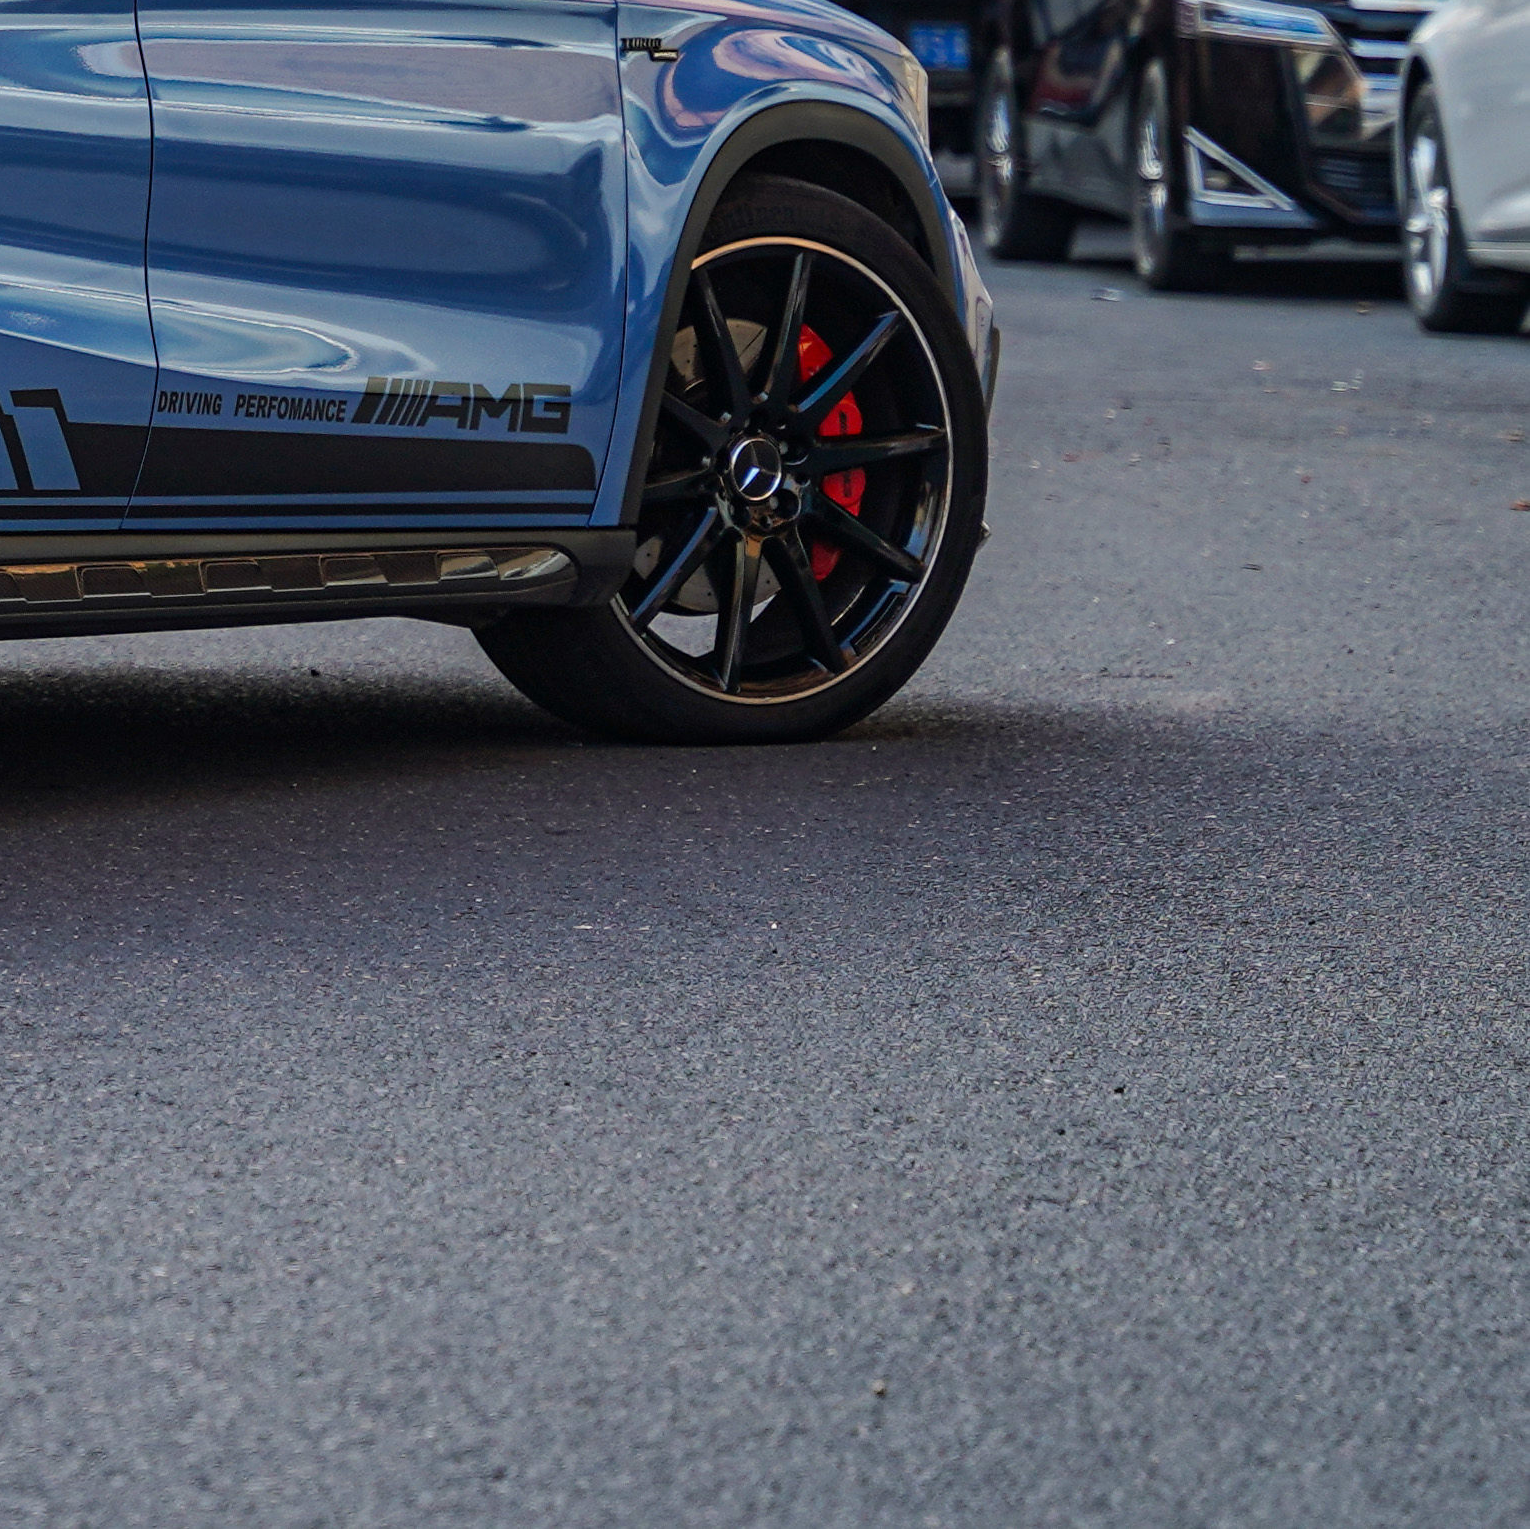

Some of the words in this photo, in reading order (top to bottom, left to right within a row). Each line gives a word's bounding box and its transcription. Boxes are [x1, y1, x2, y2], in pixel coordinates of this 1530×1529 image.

[157, 389, 222, 416] DRIVING
[233, 393, 348, 422] PERFOMANCE
[418, 380, 572, 434] AMG
